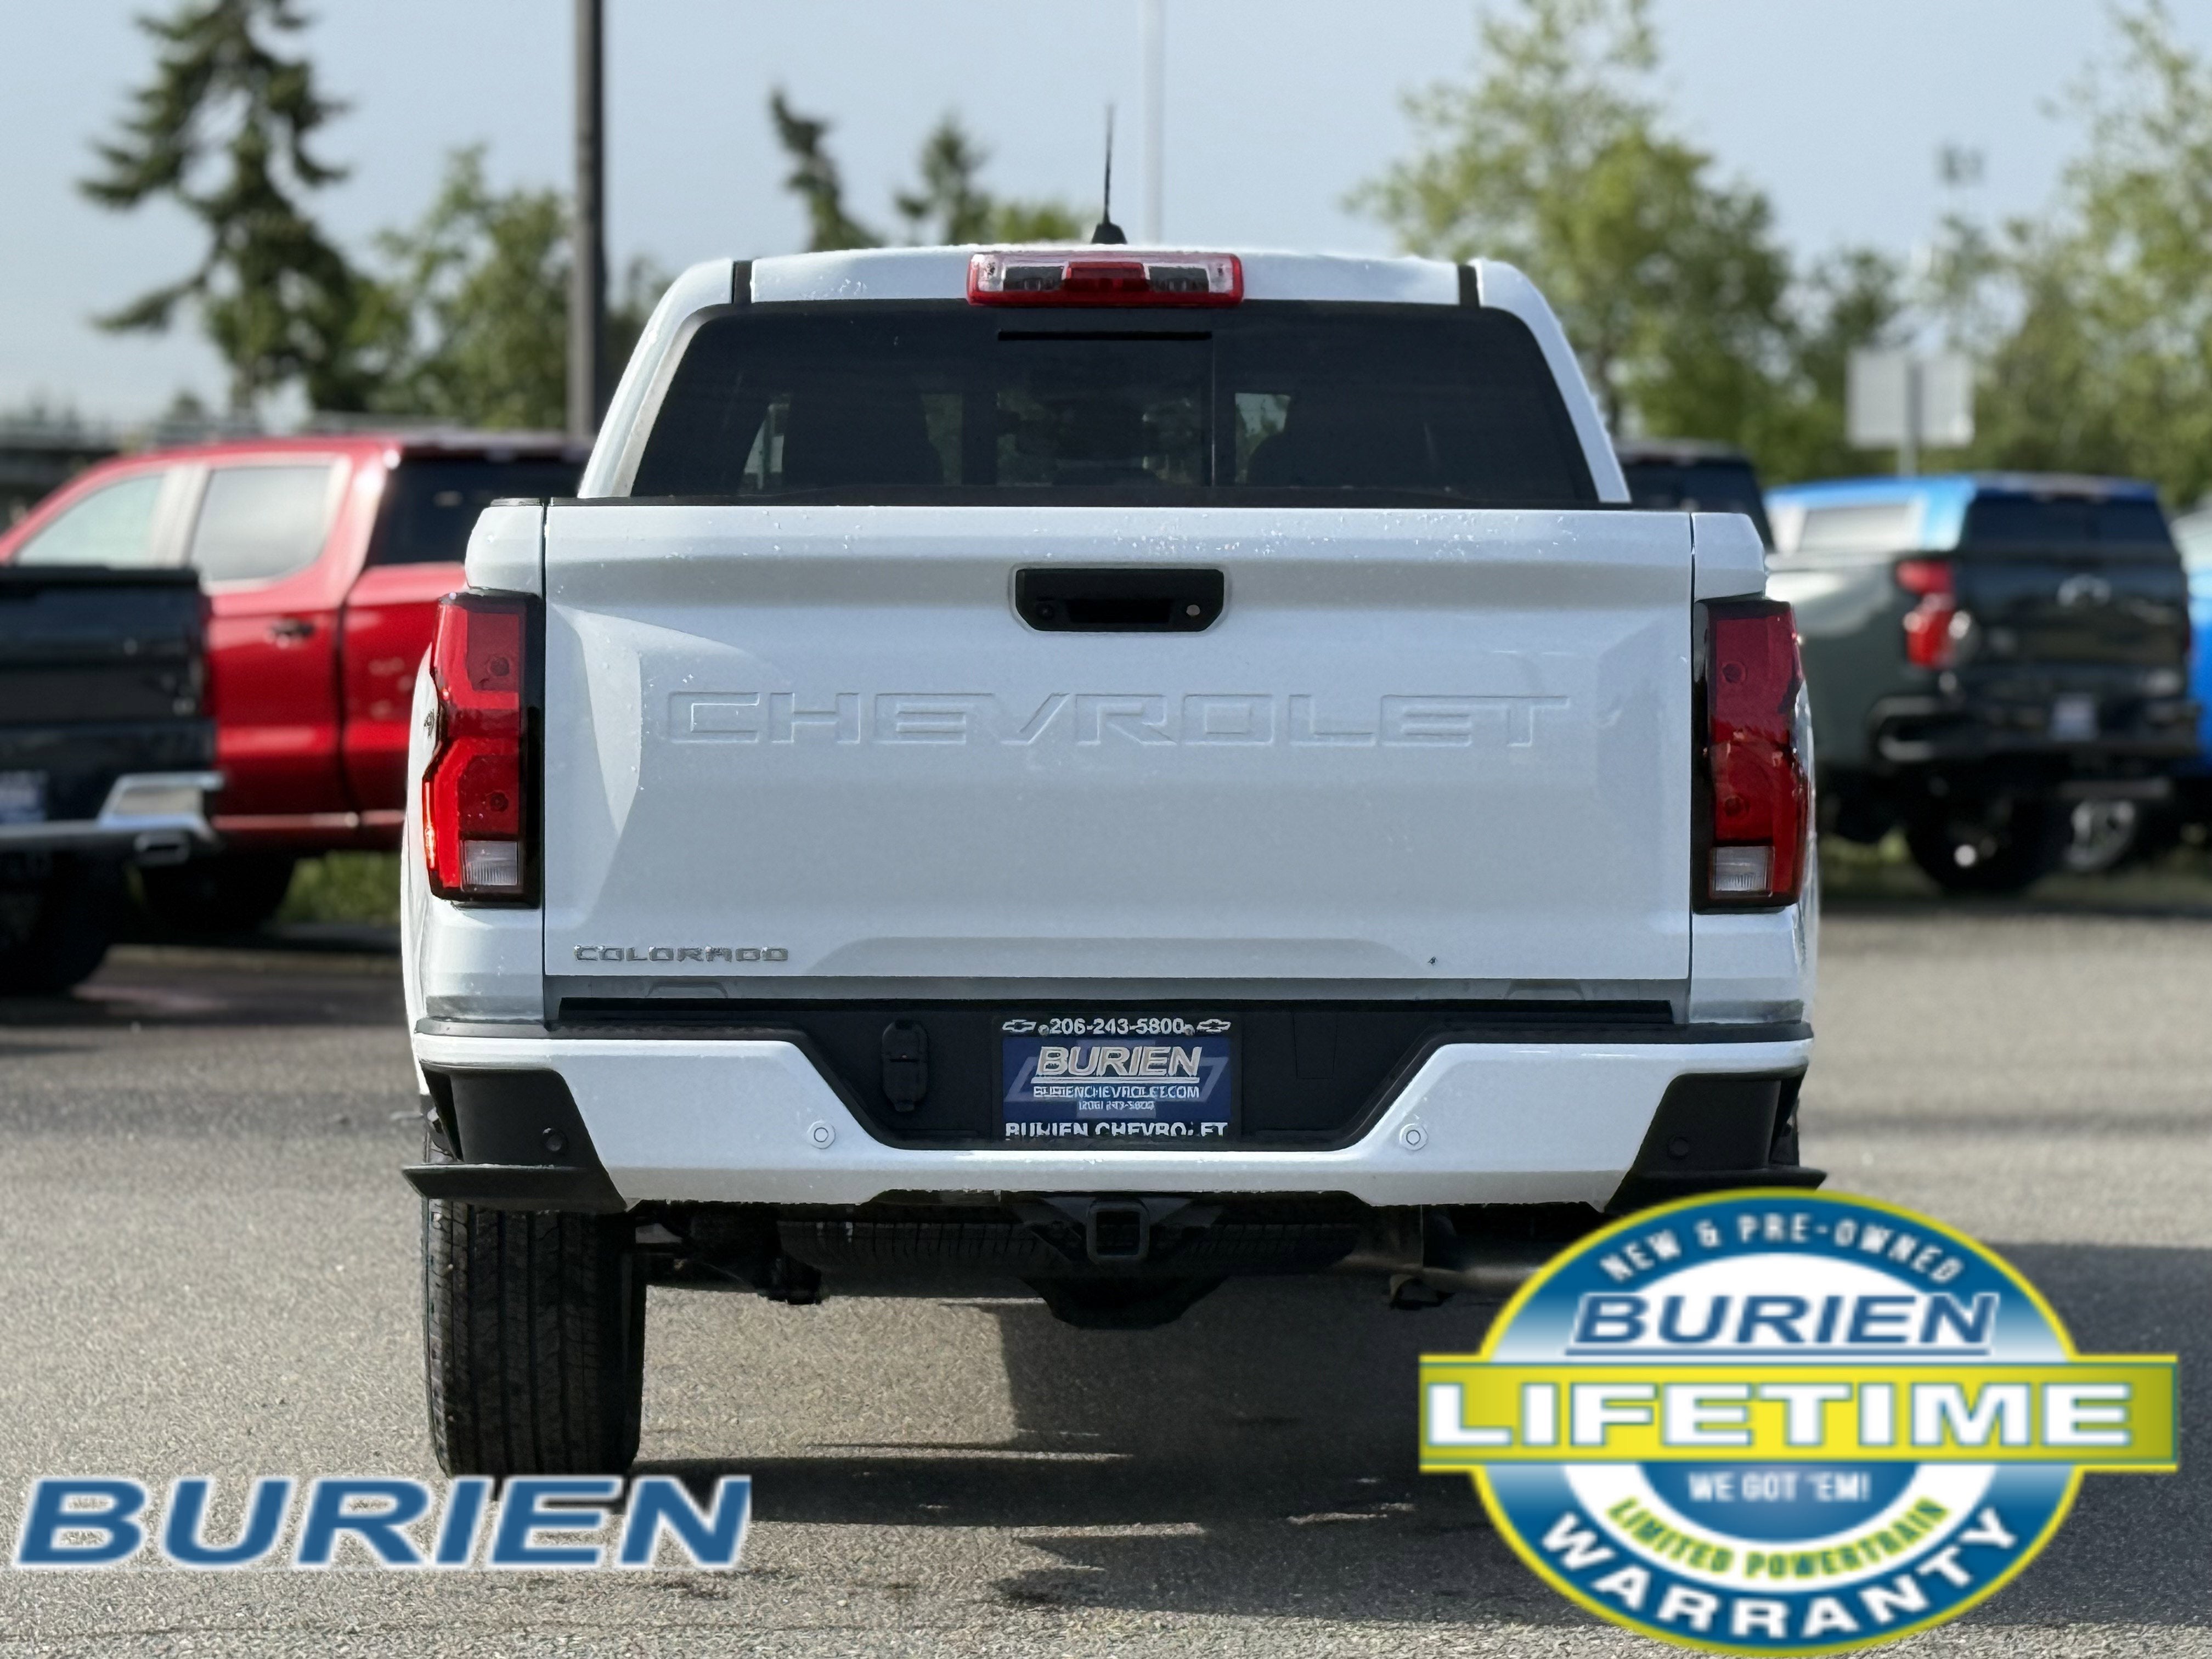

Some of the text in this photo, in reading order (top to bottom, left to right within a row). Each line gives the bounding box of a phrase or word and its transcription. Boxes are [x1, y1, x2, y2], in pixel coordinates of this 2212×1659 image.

[667, 692, 1570, 747] CHEVROLET
[574, 945, 788, 962] COLORADO
[1048, 1018, 1185, 1035] 206-243-5800
[1036, 1046, 1203, 1076] BURIEN
